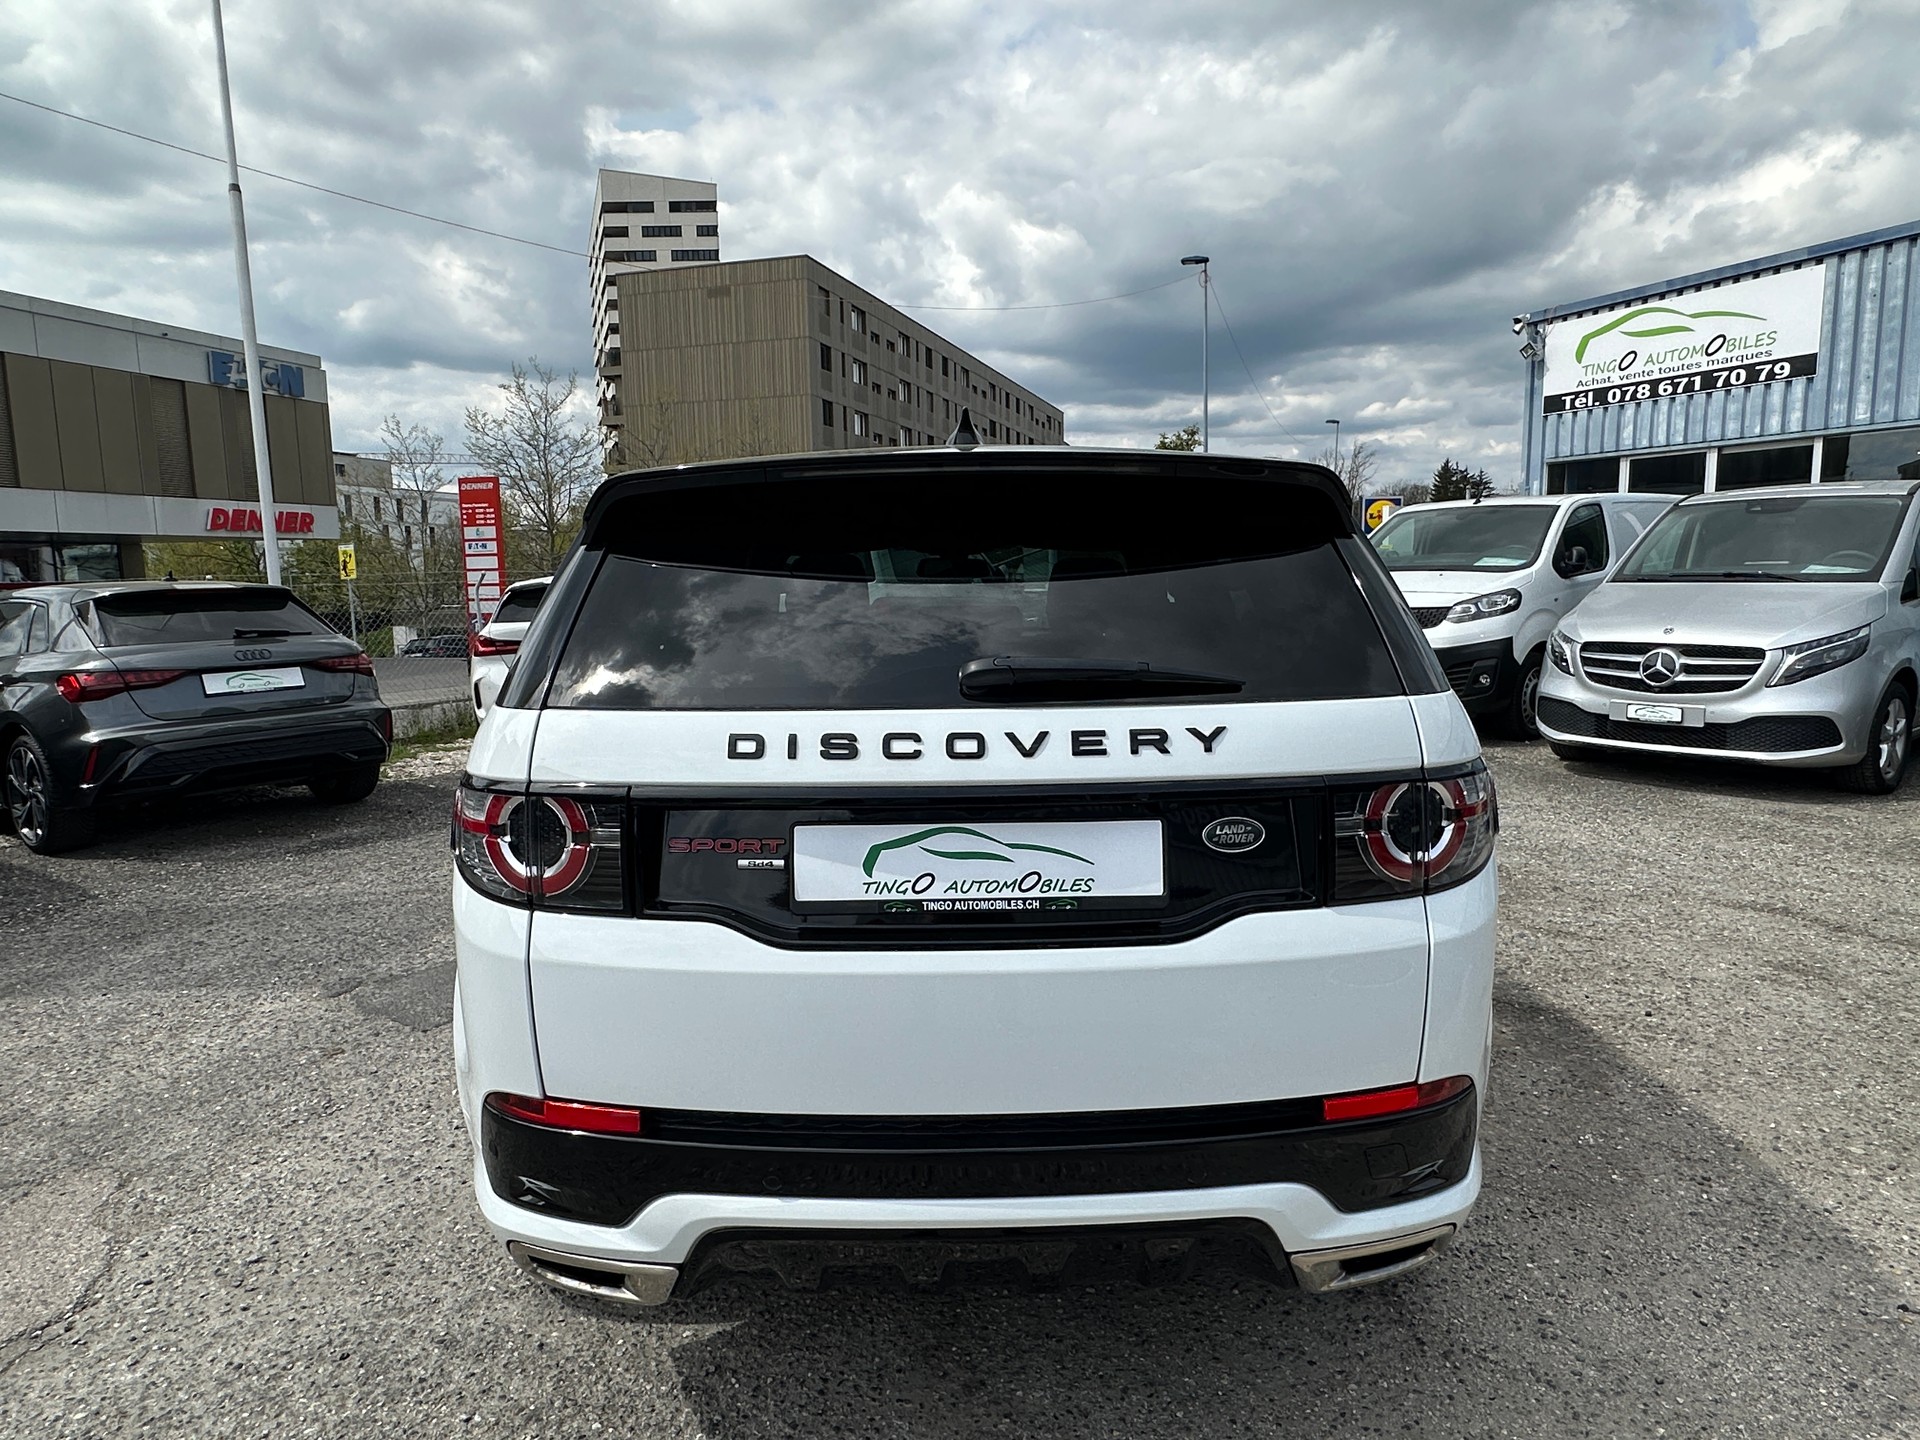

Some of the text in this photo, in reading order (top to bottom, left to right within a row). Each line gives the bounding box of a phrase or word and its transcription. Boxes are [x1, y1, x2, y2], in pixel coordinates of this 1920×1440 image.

[1581, 331, 1778, 377] TINGO AUTOMOBILES
[1576, 349, 1773, 388] Achat, vente toutes marques
[1561, 361, 1791, 410] Tél. 078 671 70 79
[727, 726, 1227, 760] DISCOVERY
[1216, 824, 1246, 834] LAND
[1219, 833, 1255, 843] ROVER
[668, 838, 785, 853] SPORT
[747, 860, 775, 868] Sd4
[862, 871, 1095, 895] TINGO AUTOMOBILES
[922, 899, 1040, 911] TINGO AUTOMOBILES.CH
